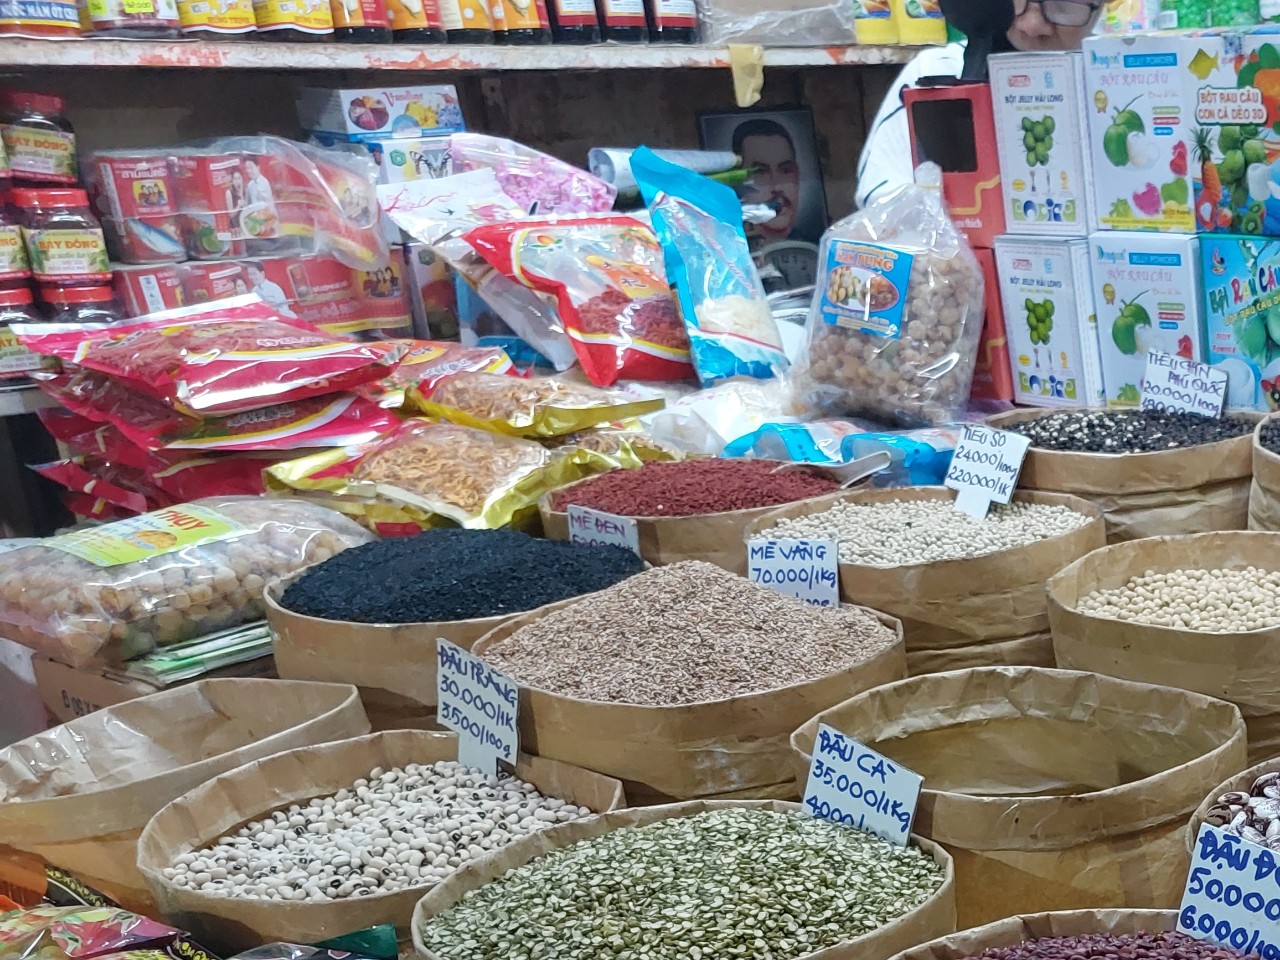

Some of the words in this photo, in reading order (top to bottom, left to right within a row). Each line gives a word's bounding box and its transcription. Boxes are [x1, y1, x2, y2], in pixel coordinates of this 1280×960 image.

[437, 645, 468, 676] ĐẬU
[441, 701, 512, 759] 3.500/100g
[819, 730, 855, 762] ĐẬU
[1199, 830, 1251, 871] ĐẬU
